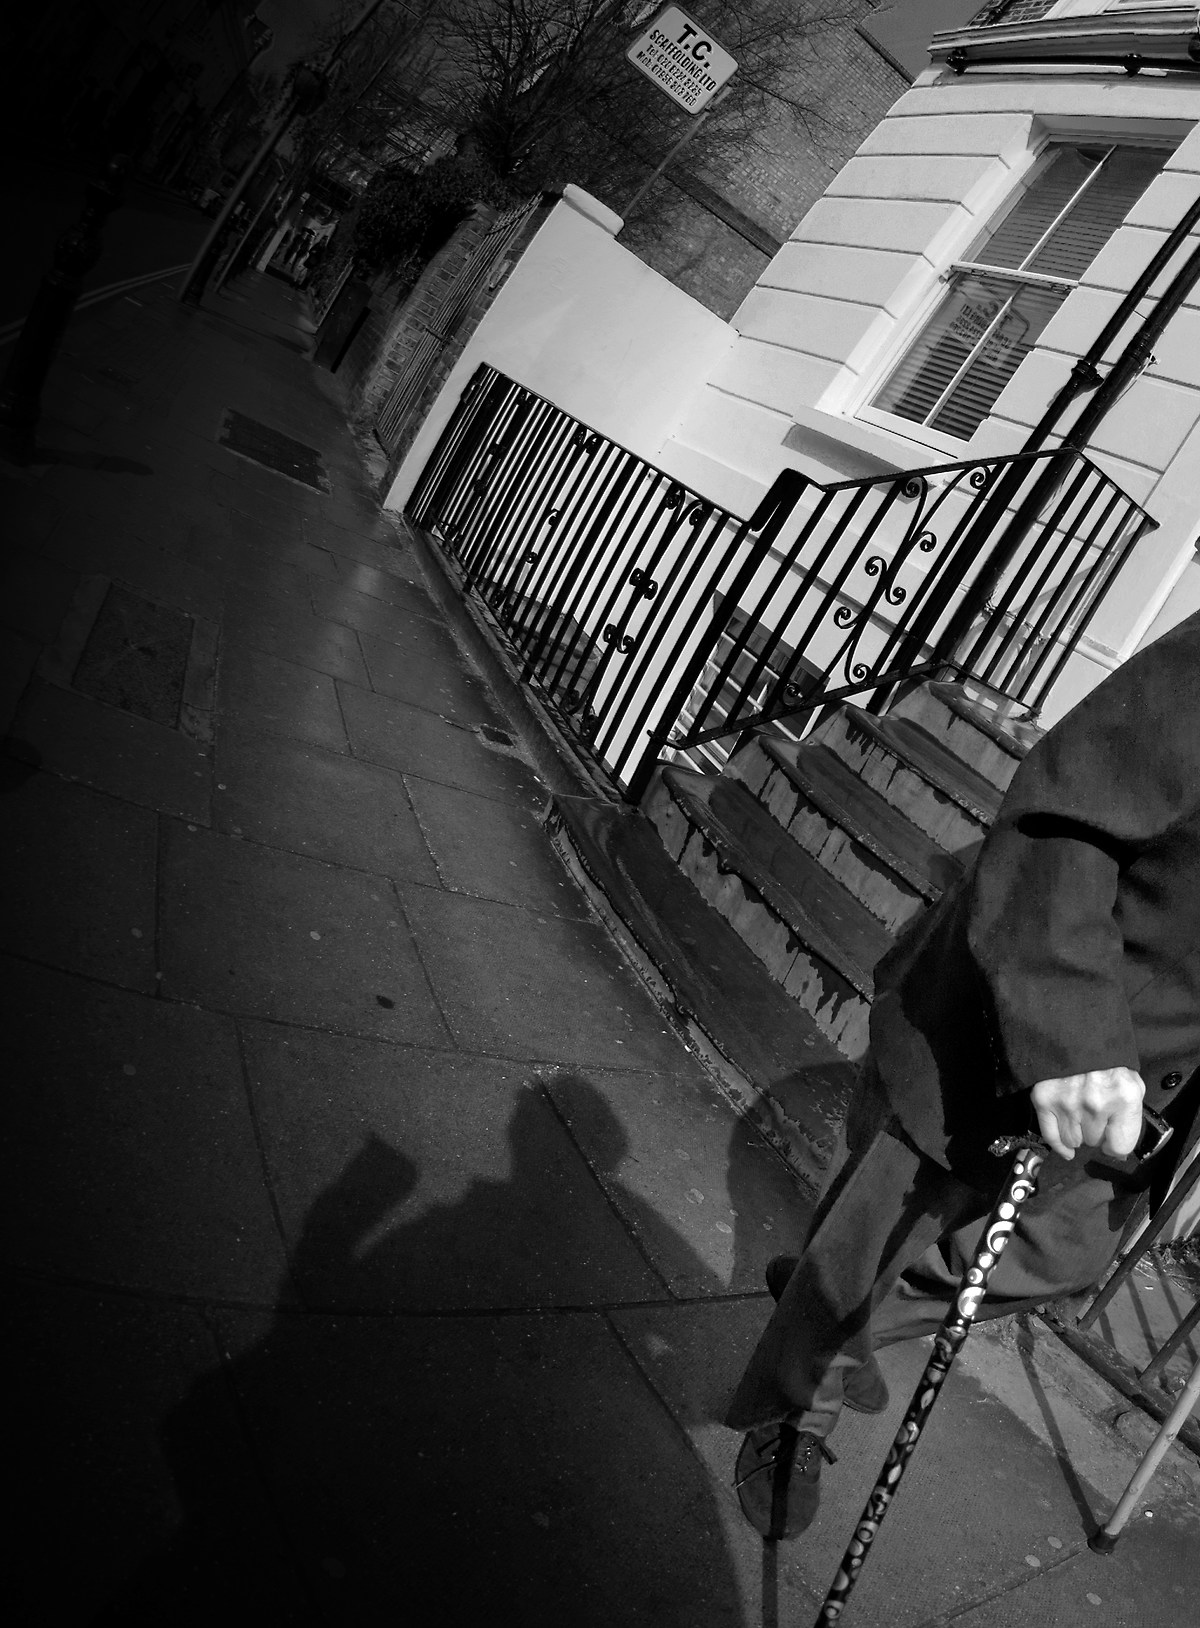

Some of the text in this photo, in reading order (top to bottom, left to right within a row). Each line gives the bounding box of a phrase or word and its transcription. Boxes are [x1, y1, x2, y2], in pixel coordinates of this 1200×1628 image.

[649, 29, 717, 92] SCAFFOLDING LTD
[676, 23, 712, 69] T.C.
